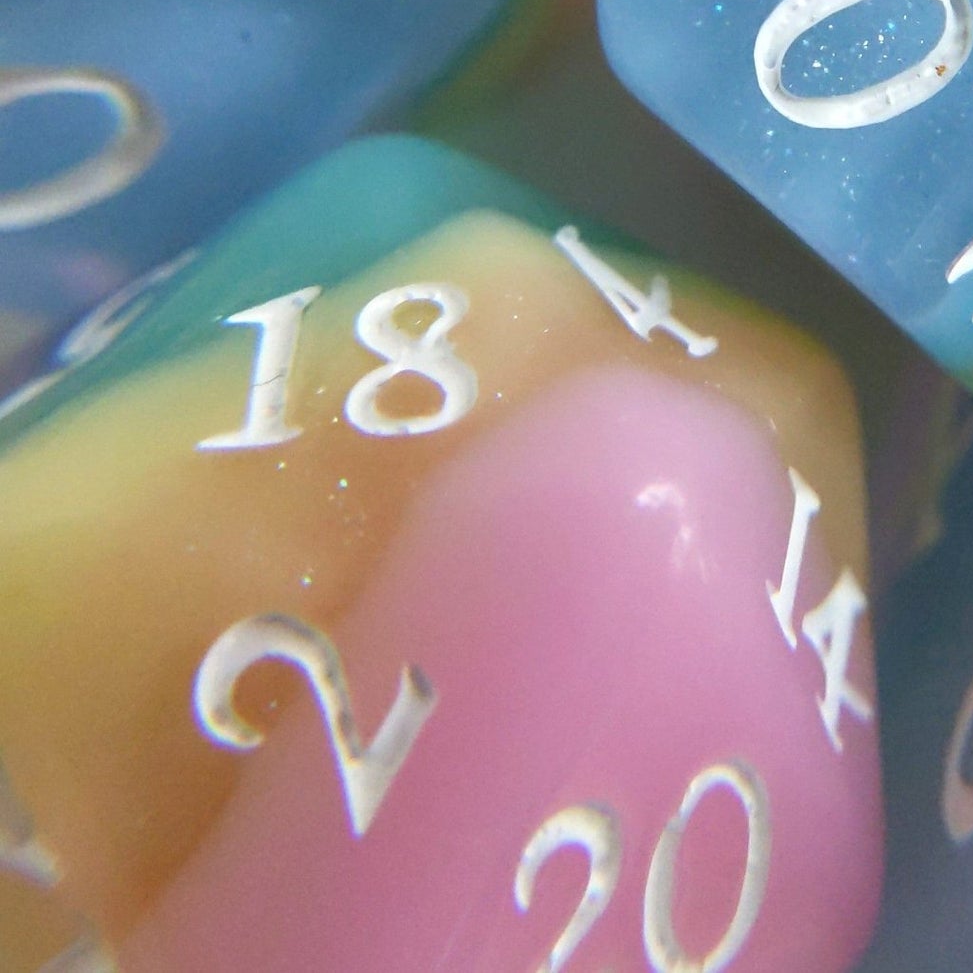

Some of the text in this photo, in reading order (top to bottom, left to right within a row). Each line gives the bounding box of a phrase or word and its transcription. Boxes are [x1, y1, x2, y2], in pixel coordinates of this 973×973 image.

[195, 283, 480, 452] 18
[553, 224, 718, 359] 4
[765, 465, 876, 756] 14
[191, 612, 440, 839] 2
[513, 758, 773, 973] 20
